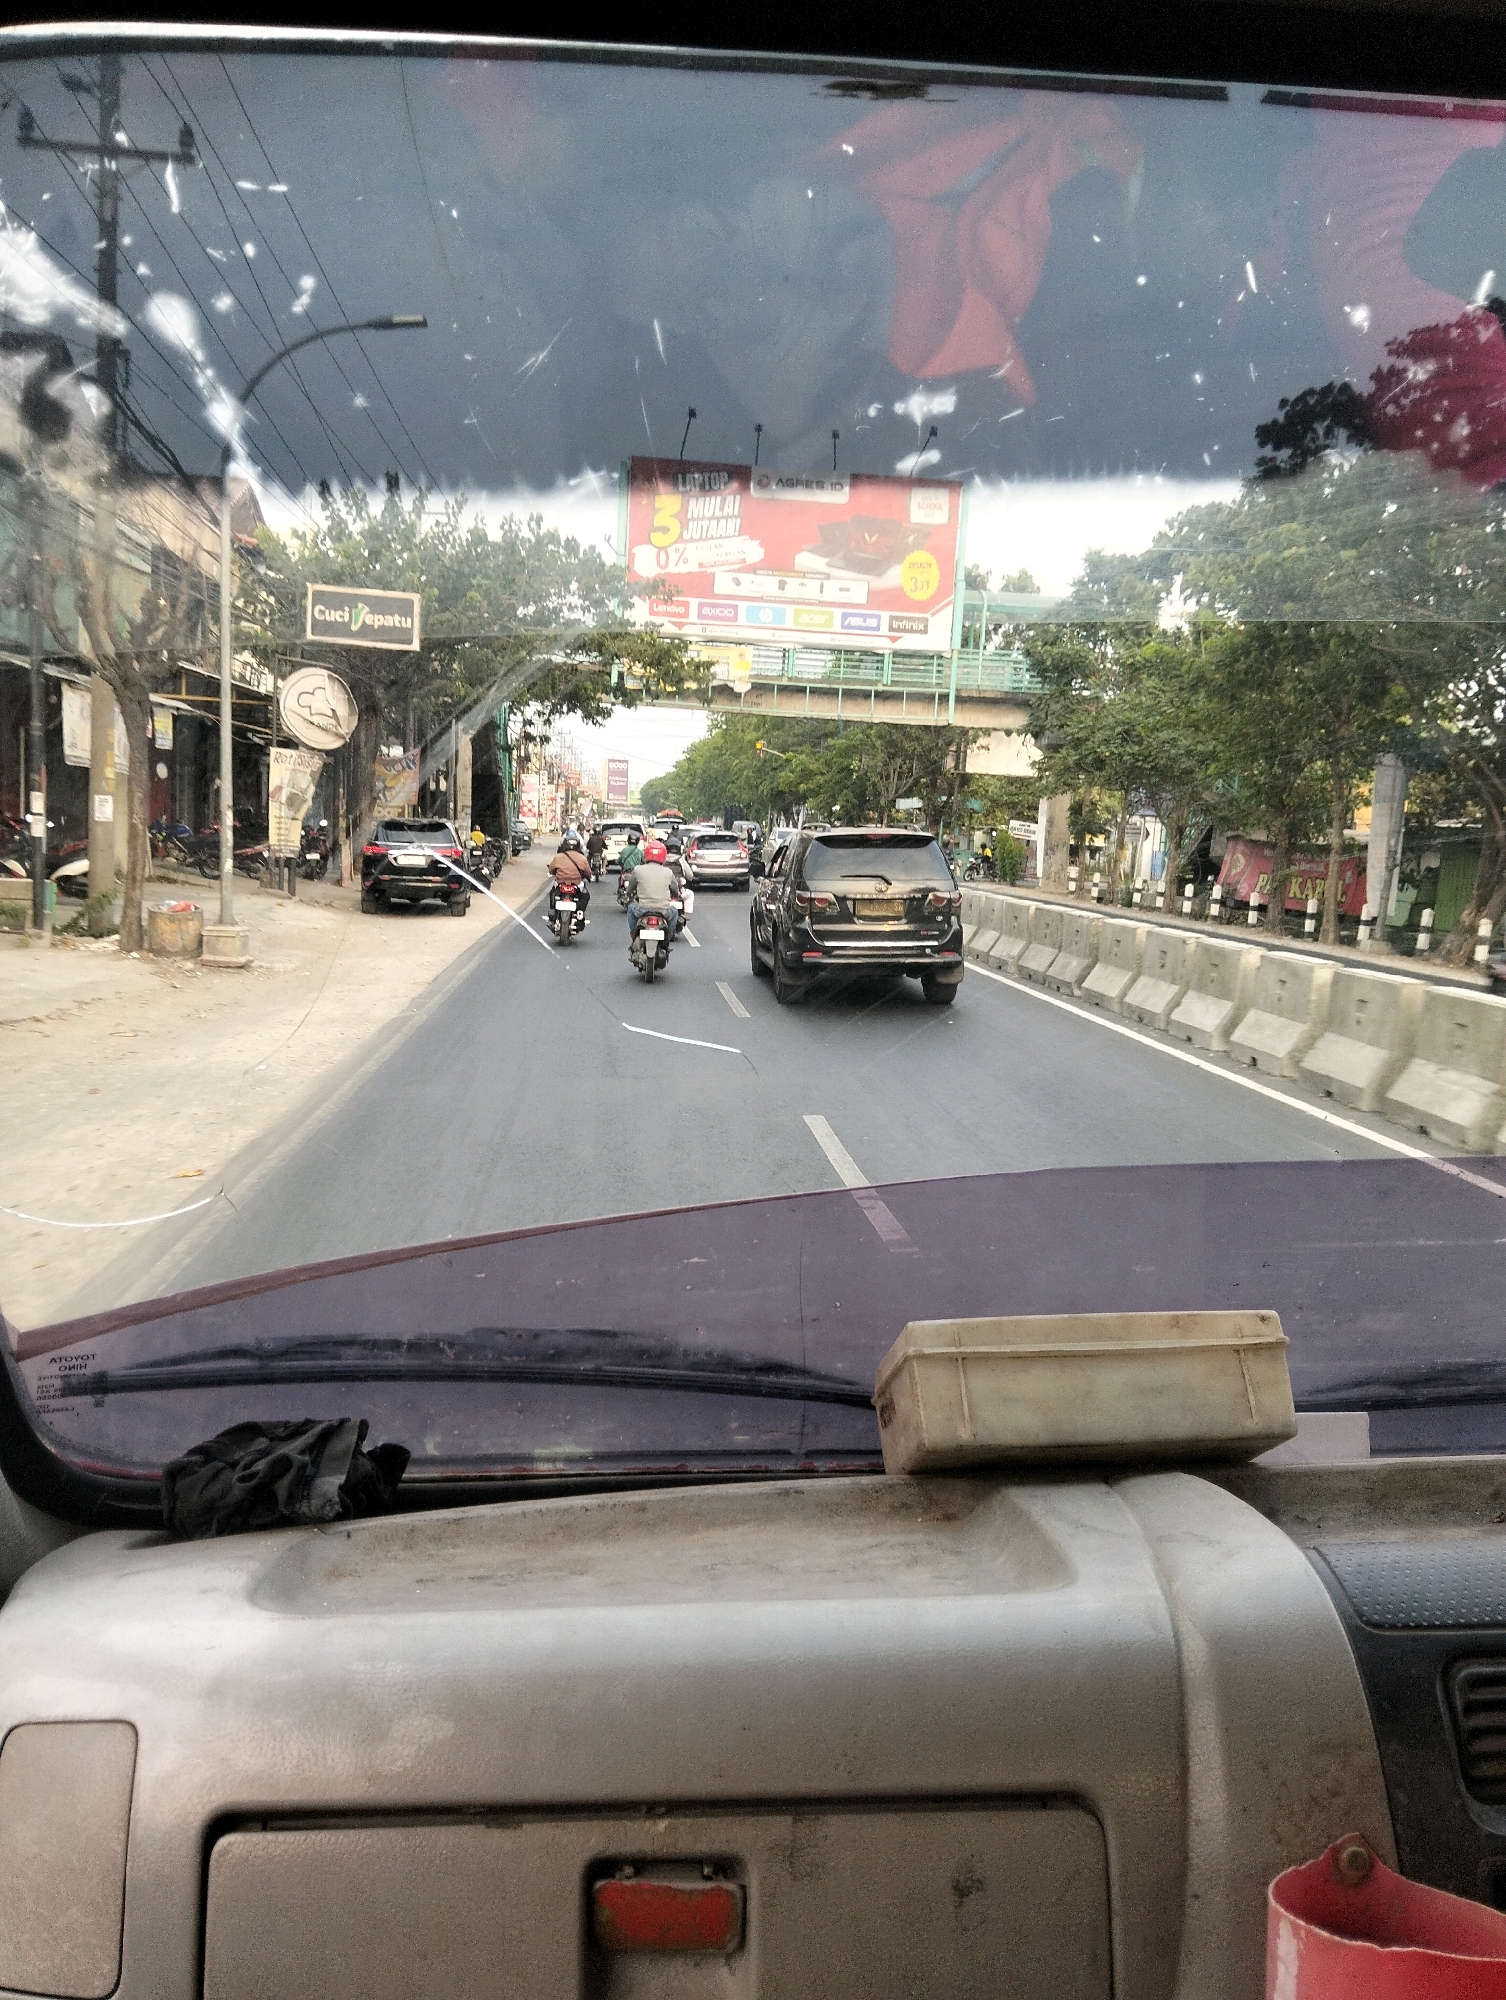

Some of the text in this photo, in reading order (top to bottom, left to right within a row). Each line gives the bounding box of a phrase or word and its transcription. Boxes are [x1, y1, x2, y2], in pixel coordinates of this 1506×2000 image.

[677, 472, 729, 492] LAPTOP
[687, 495, 741, 519] MULAI
[650, 494, 682, 548] 3
[682, 518, 741, 540] JUTAAN!
[909, 561, 932, 569] DISKON
[313, 604, 350, 623] Cuci
[653, 602, 685, 614] Lenovo
[798, 613, 829, 624] acer
[844, 616, 878, 628] ASUS
[1288, 876, 1347, 902] KABL
